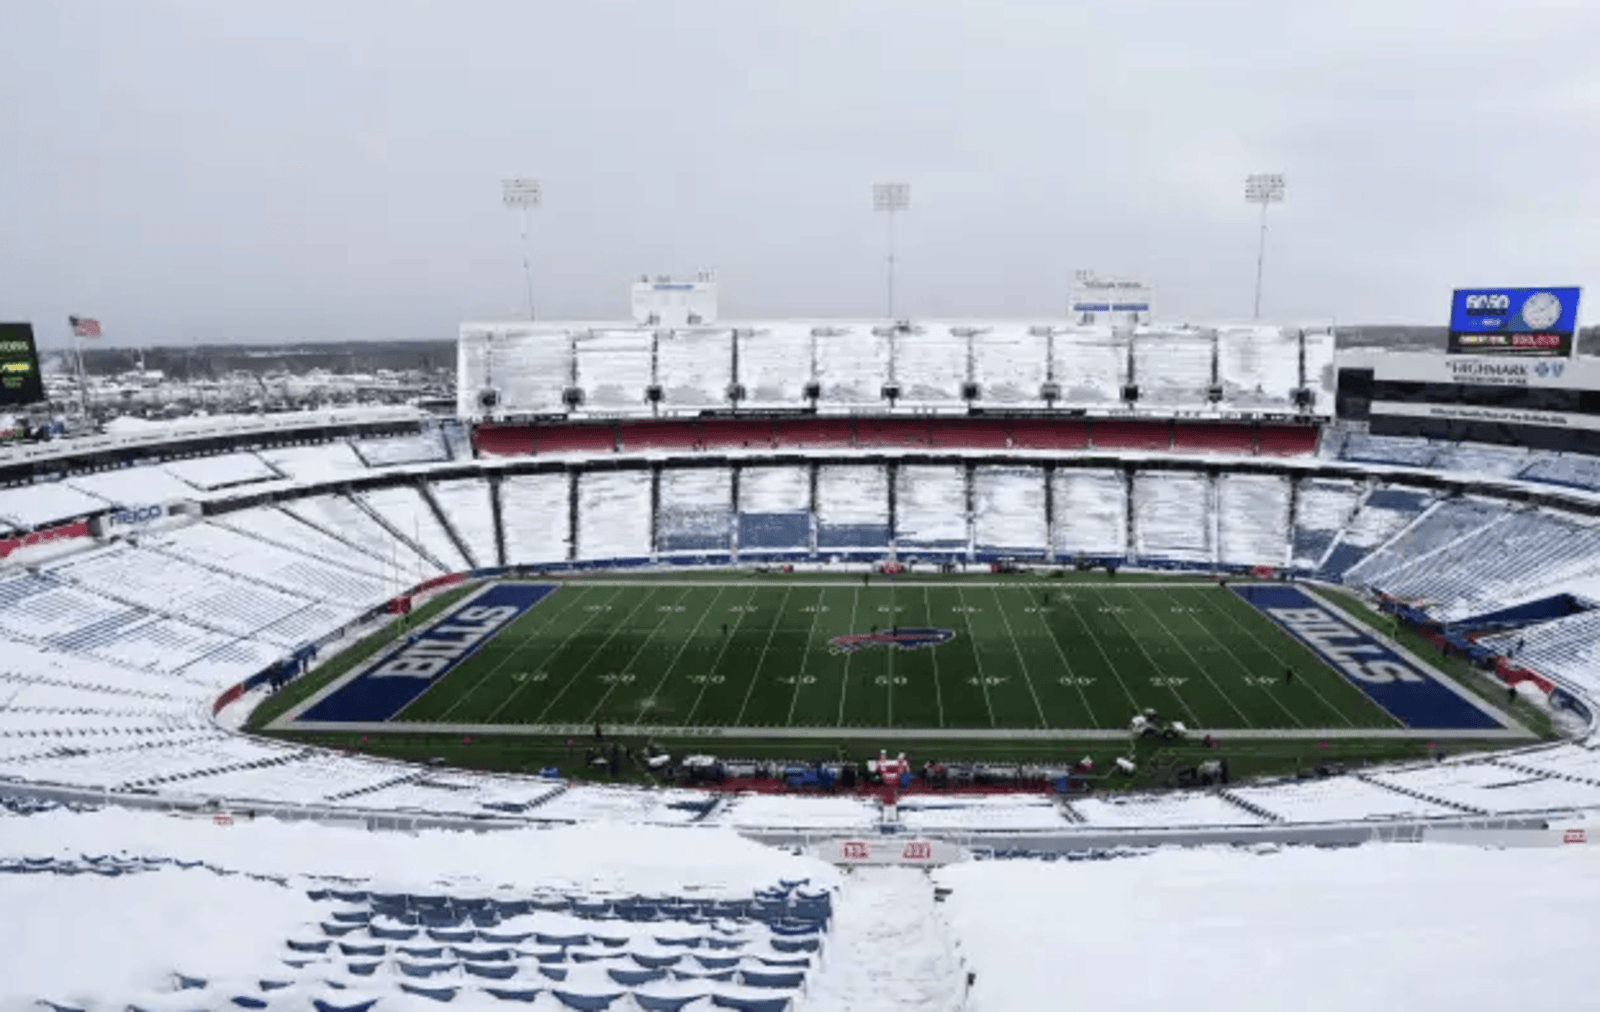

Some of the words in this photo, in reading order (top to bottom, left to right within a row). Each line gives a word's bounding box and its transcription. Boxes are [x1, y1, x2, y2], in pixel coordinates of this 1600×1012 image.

[1452, 360, 1527, 375] HIGHMARK
[370, 605, 520, 678] BILLS
[1267, 607, 1426, 684] BILLS
